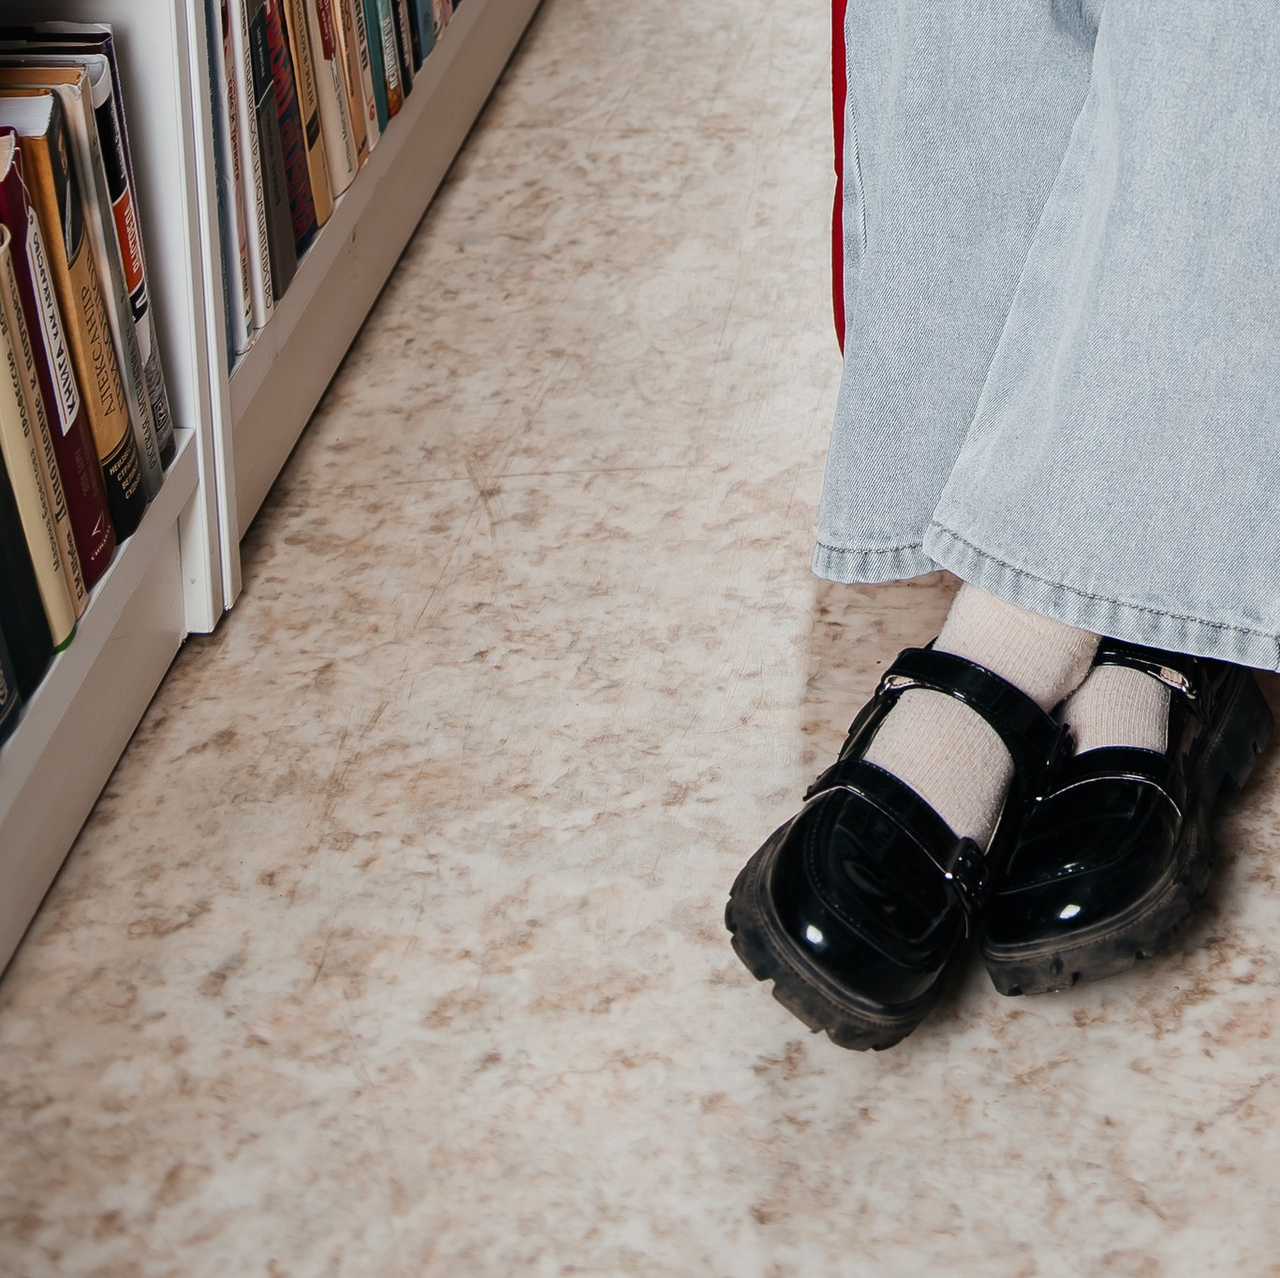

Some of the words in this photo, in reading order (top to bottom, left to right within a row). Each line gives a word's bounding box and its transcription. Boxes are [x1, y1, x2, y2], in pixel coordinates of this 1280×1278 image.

[304, 66, 315, 106] ИГРЫ,
[360, 46, 369, 71] КАК
[282, 118, 316, 237] ВЫБОР
[343, 142, 353, 173] Антон
[33, 231, 55, 309] ЛЕКАРСТВО
[256, 177, 273, 309] ПОМЕШАТЕЛЬСТВО
[47, 311, 60, 340] КАК
[77, 283, 116, 416] АЛЕКСАНДР
[7, 348, 32, 438] ПРОФЕССИЯ
[54, 339, 78, 415] КНИГА
[34, 395, 68, 524] Дополнение
[42, 518, 62, 572] Марина
